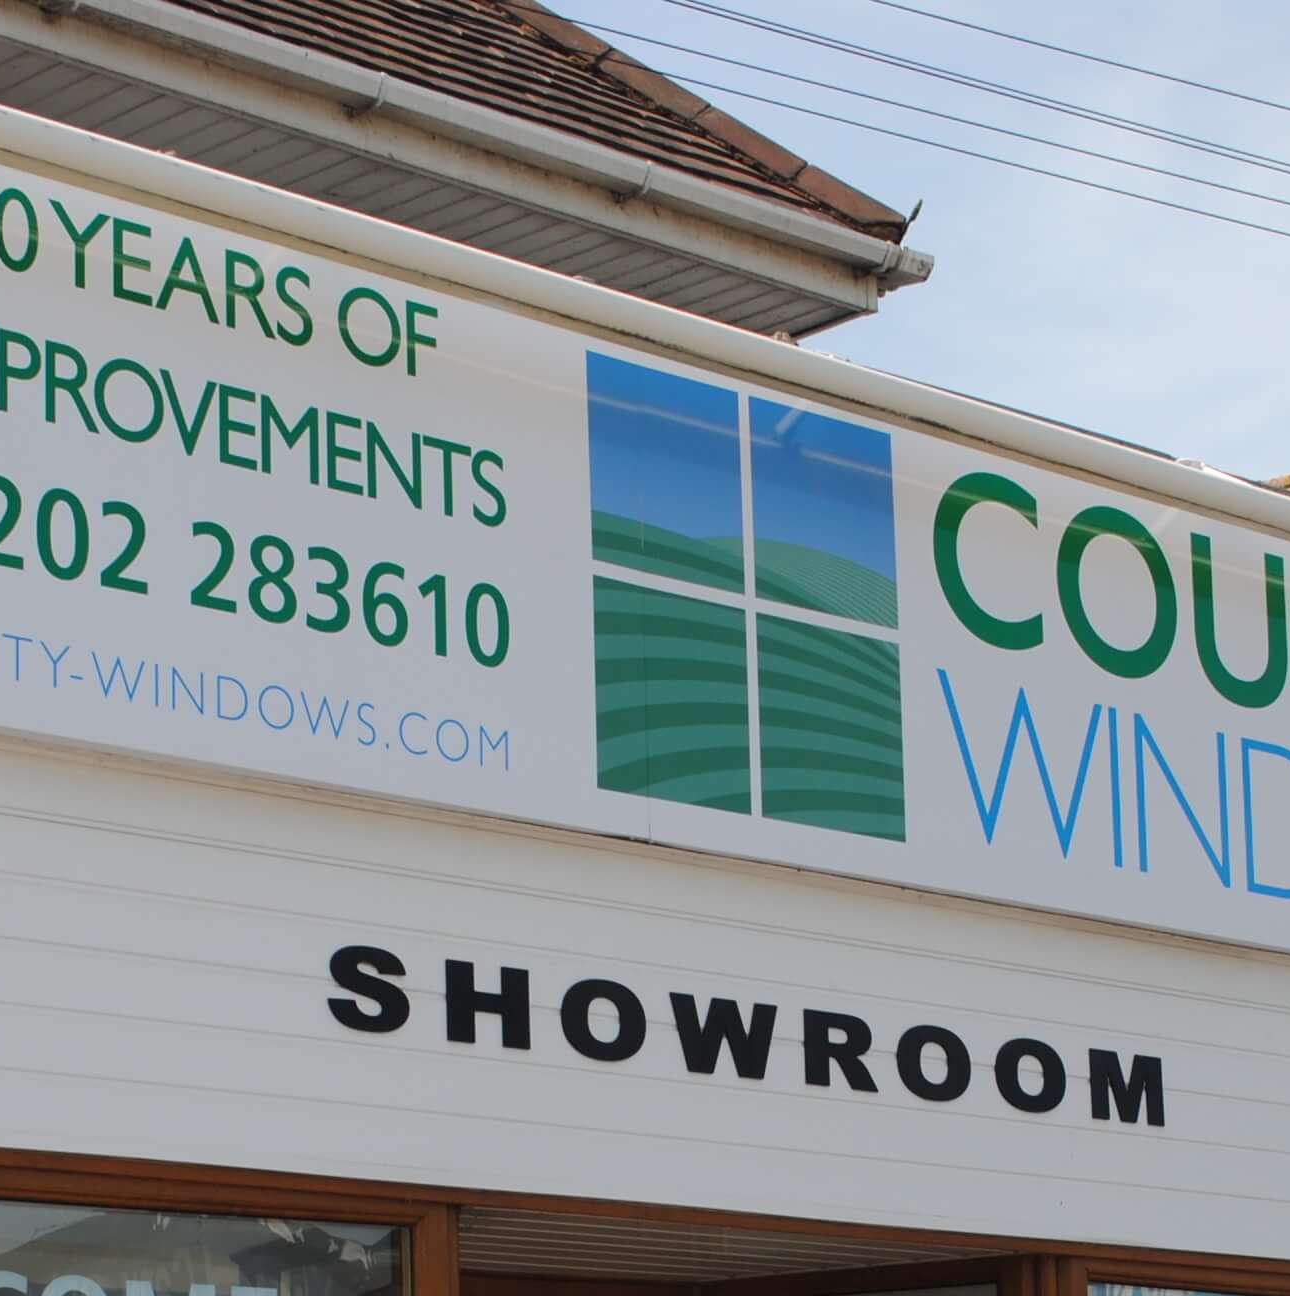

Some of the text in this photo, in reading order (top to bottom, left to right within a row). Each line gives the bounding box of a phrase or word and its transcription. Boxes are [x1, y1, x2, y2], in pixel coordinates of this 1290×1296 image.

[49, 198, 312, 346] YEARS
[336, 286, 440, 377] OF
[189, 520, 510, 668] 283610
[326, 944, 1166, 1128] SHOWROOM
